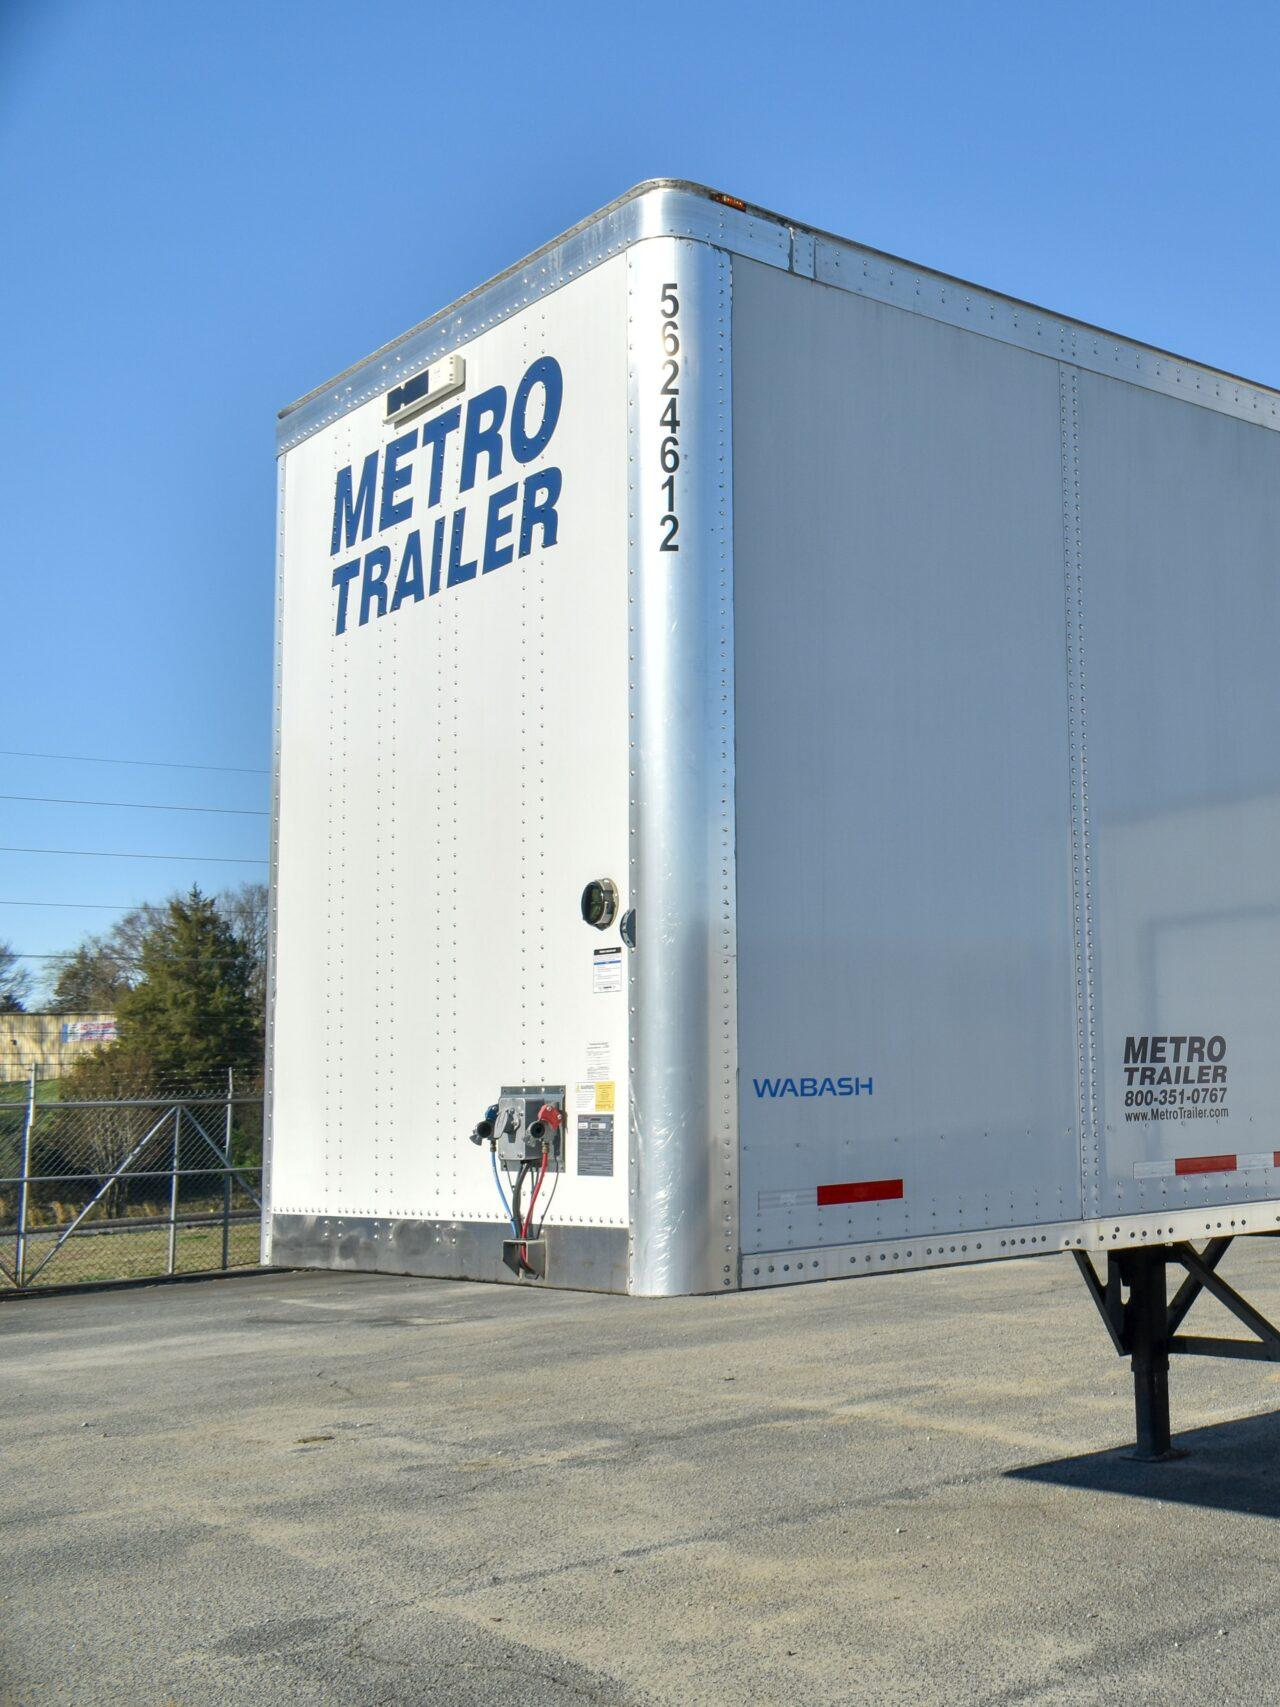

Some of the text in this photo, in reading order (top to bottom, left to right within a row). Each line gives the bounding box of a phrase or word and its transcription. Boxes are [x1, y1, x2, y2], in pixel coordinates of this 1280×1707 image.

[660, 283, 680, 552] 5624612
[330, 356, 563, 556] METRO
[331, 466, 563, 638] TRAILER
[1123, 1035, 1227, 1065] METRO
[752, 1077, 873, 1098] WABASH
[1124, 1065, 1228, 1086] TRAILER
[1124, 1087, 1228, 1107] 800-351-0767
[1125, 1106, 1229, 1122] www.MetroTrailer.com
